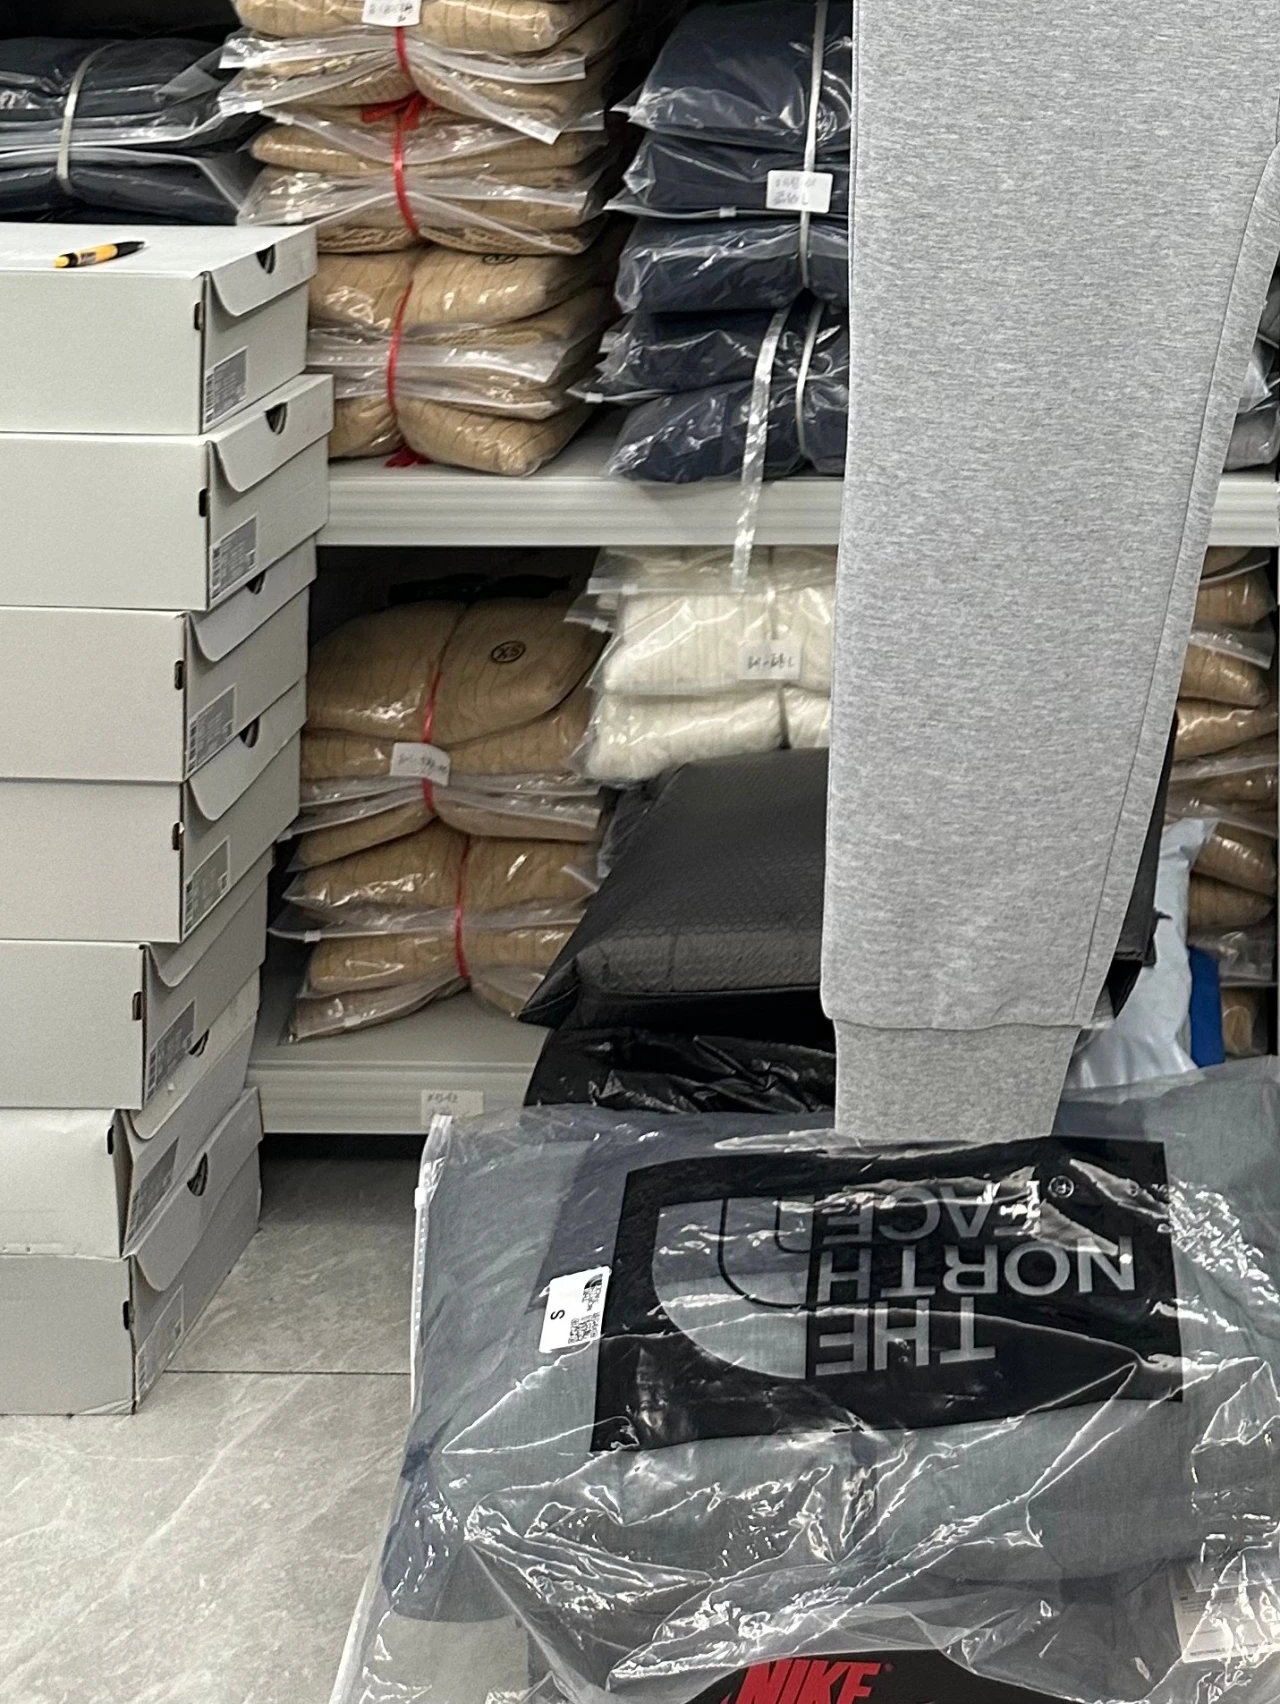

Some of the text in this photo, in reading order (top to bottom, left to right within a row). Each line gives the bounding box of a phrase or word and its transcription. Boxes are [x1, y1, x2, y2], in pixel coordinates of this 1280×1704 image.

[816, 1236, 1137, 1303] NORTH
[550, 1308, 566, 1321] S
[814, 1296, 996, 1376] THE
